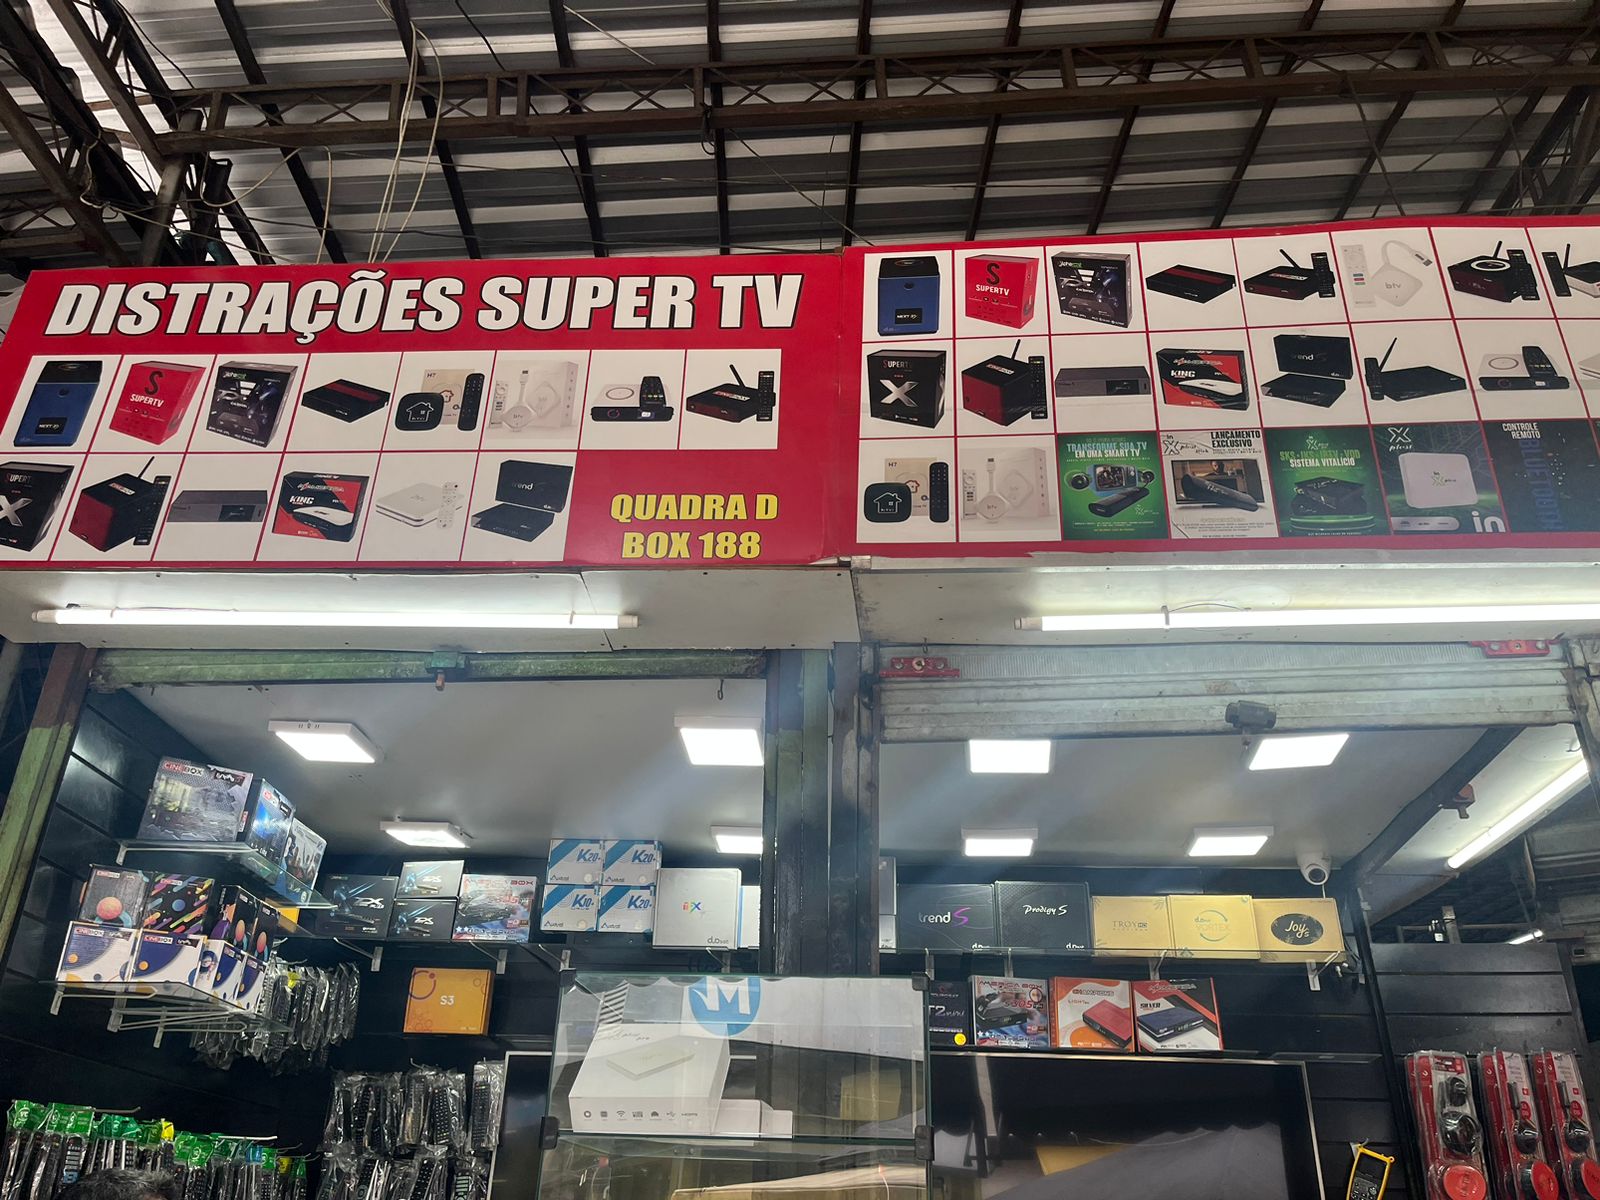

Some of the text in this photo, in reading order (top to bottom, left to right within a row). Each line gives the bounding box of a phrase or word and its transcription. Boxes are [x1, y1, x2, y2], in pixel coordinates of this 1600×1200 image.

[975, 284, 1010, 296] SUPERTV
[45, 270, 804, 345] DISTRAÇÕES SUPER TV
[1170, 369, 1196, 378] KING
[130, 393, 164, 408] SUPERTV
[1502, 422, 1539, 432] CONTROLE
[1211, 430, 1261, 441] LANÇAMENTO
[1511, 430, 1541, 440] REMOTO
[1067, 441, 1147, 453] TRANSFORME SUA TV
[1212, 439, 1253, 448] EXCLUSIVO
[1075, 449, 1141, 459] EM UMA SMART TV
[1344, 449, 1361, 459] VOD
[1290, 456, 1356, 468] SISTEMA VITALÍCIO
[289, 495, 315, 505] KING
[610, 493, 779, 524] QUADRA D
[1471, 511, 1506, 533] in
[621, 531, 762, 559] BOX 188
[162, 760, 205, 778] CINEBOX
[577, 848, 601, 862] K20+
[632, 849, 656, 863] K20+
[628, 895, 652, 909] K20+
[1023, 904, 1069, 917] Prodigy S
[918, 906, 972, 928] trend S
[1113, 920, 1137, 928] TROY
[979, 980, 1020, 989] AMERICA
[1072, 988, 1115, 997] CHAMPIONS
[440, 995, 455, 1006] S3
[1140, 1002, 1161, 1010] SILVER
